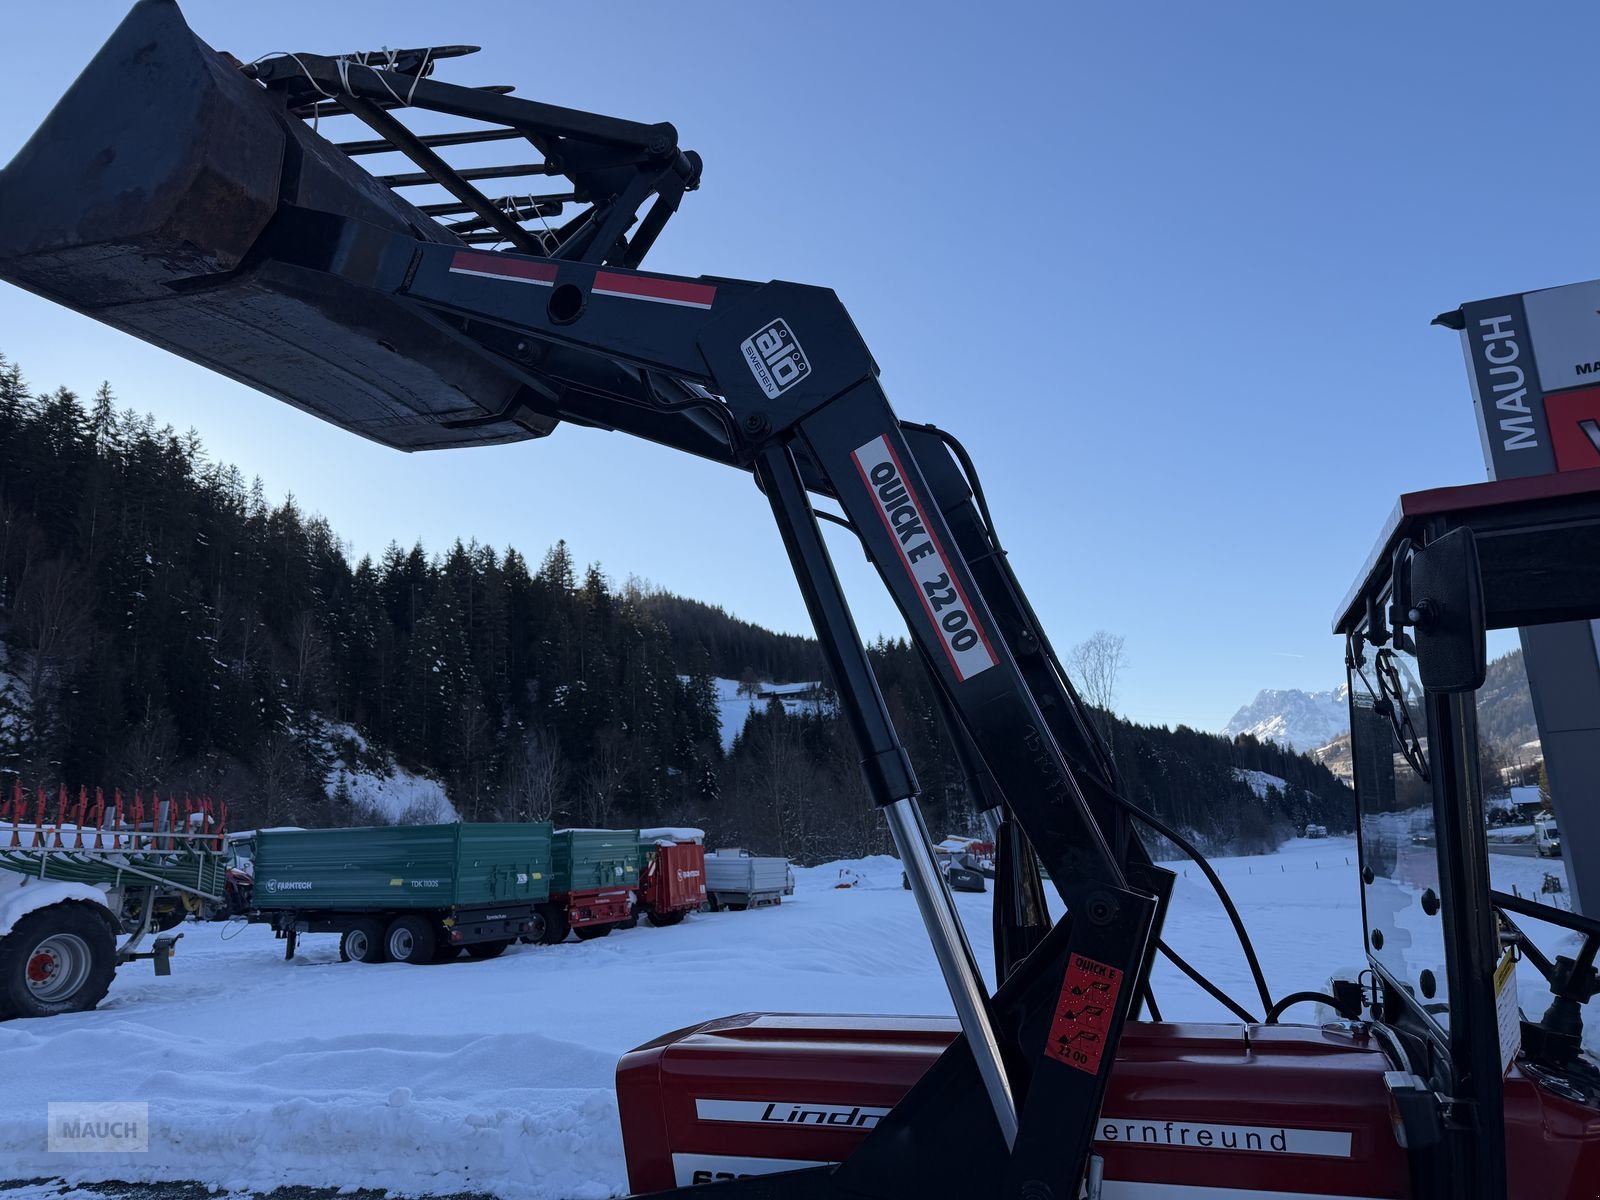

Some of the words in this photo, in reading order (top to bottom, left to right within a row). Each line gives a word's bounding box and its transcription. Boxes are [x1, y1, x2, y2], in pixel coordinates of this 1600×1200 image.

[745, 346, 775, 393] SWEDEN
[1479, 314, 1539, 452] MAUCH
[870, 461, 927, 546] QUICK
[907, 540, 936, 565] E
[1075, 957, 1106, 977] QUICK
[1108, 969, 1116, 979] E
[1103, 1122, 1287, 1152] ernfreund
